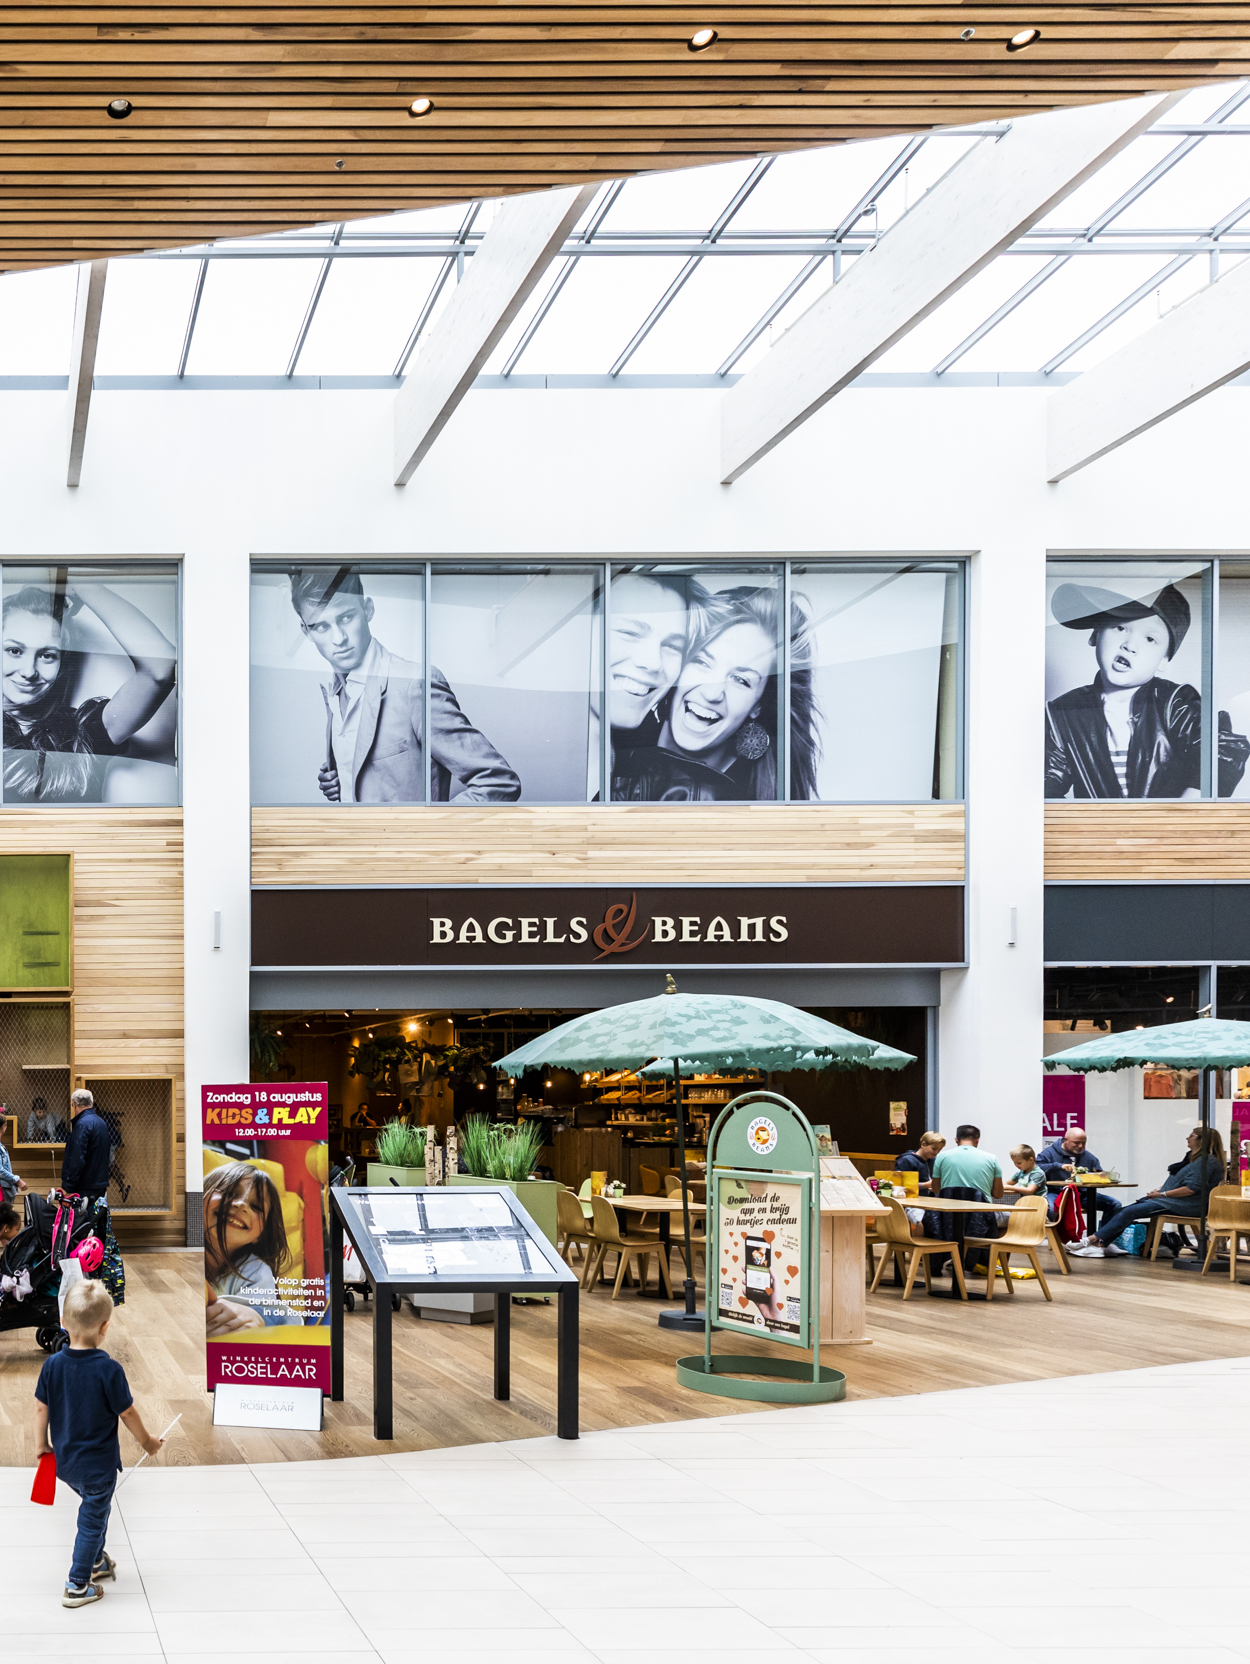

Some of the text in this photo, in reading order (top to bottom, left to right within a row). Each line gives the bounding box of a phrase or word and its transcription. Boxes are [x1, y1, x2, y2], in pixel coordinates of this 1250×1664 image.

[429, 891, 789, 960] BAGELS & BEANS
[206, 1091, 322, 1104] Zondag 18 augustus
[205, 1107, 322, 1124] KIDS & PLAY
[235, 1128, 277, 1136] 12.00-17.00
[727, 1192, 780, 1205] Download de
[740, 1206, 755, 1216] app
[769, 1203, 790, 1216] krijg
[736, 1216, 764, 1228] hartjes
[766, 1213, 797, 1225] cadeau
[272, 1277, 325, 1287] Volop gratis
[240, 1287, 325, 1296] kinderactiviteiten in
[248, 1297, 260, 1305] de
[262, 1298, 311, 1307] binnenstad
[263, 1308, 325, 1317] in de Roselaar
[221, 1362, 316, 1379] ROSELAAR
[240, 1402, 294, 1412] ROSELAAR
